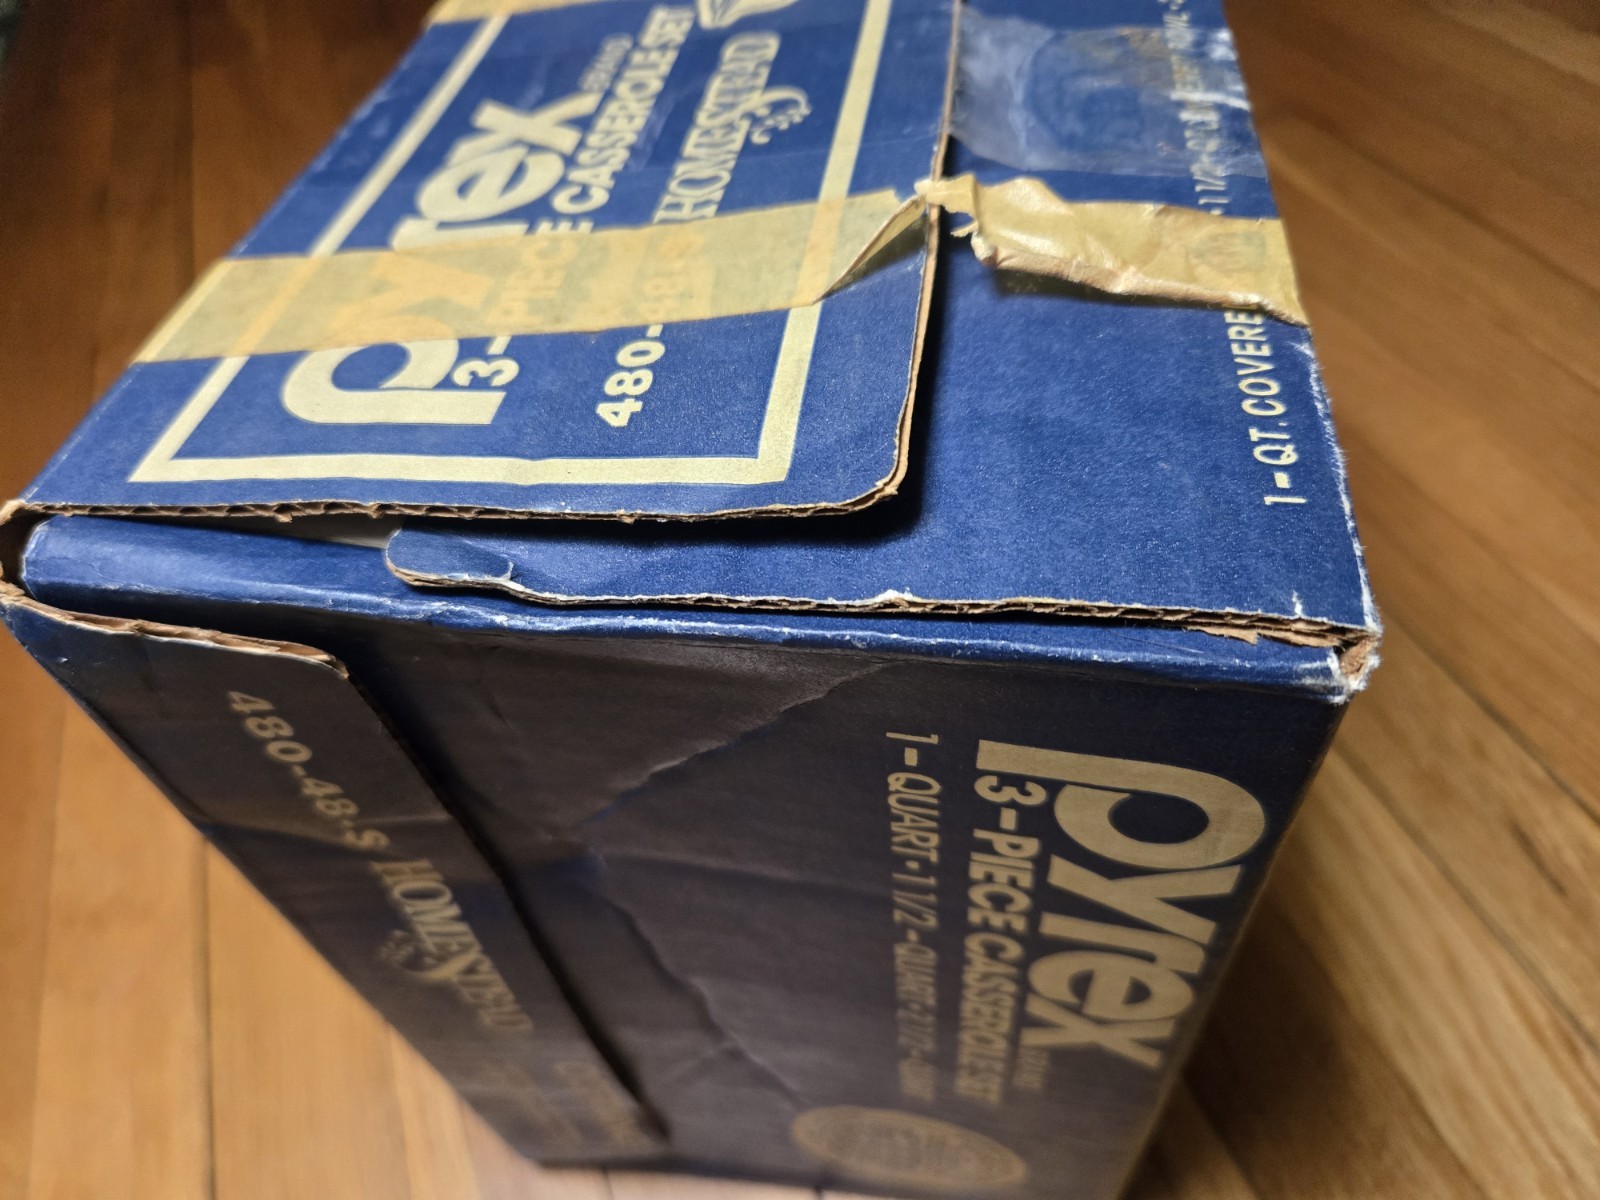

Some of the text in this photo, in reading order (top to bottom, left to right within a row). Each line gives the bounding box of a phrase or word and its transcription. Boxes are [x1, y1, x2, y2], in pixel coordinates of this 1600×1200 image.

[552, 49, 681, 214] CASSEROLE
[640, 5, 695, 48] SET
[1222, 301, 1286, 417] COVERE
[967, 775, 1047, 934] 3-PIECE
[976, 739, 1266, 1069] pyrex
[956, 932, 1026, 1072] CASSEROLE
